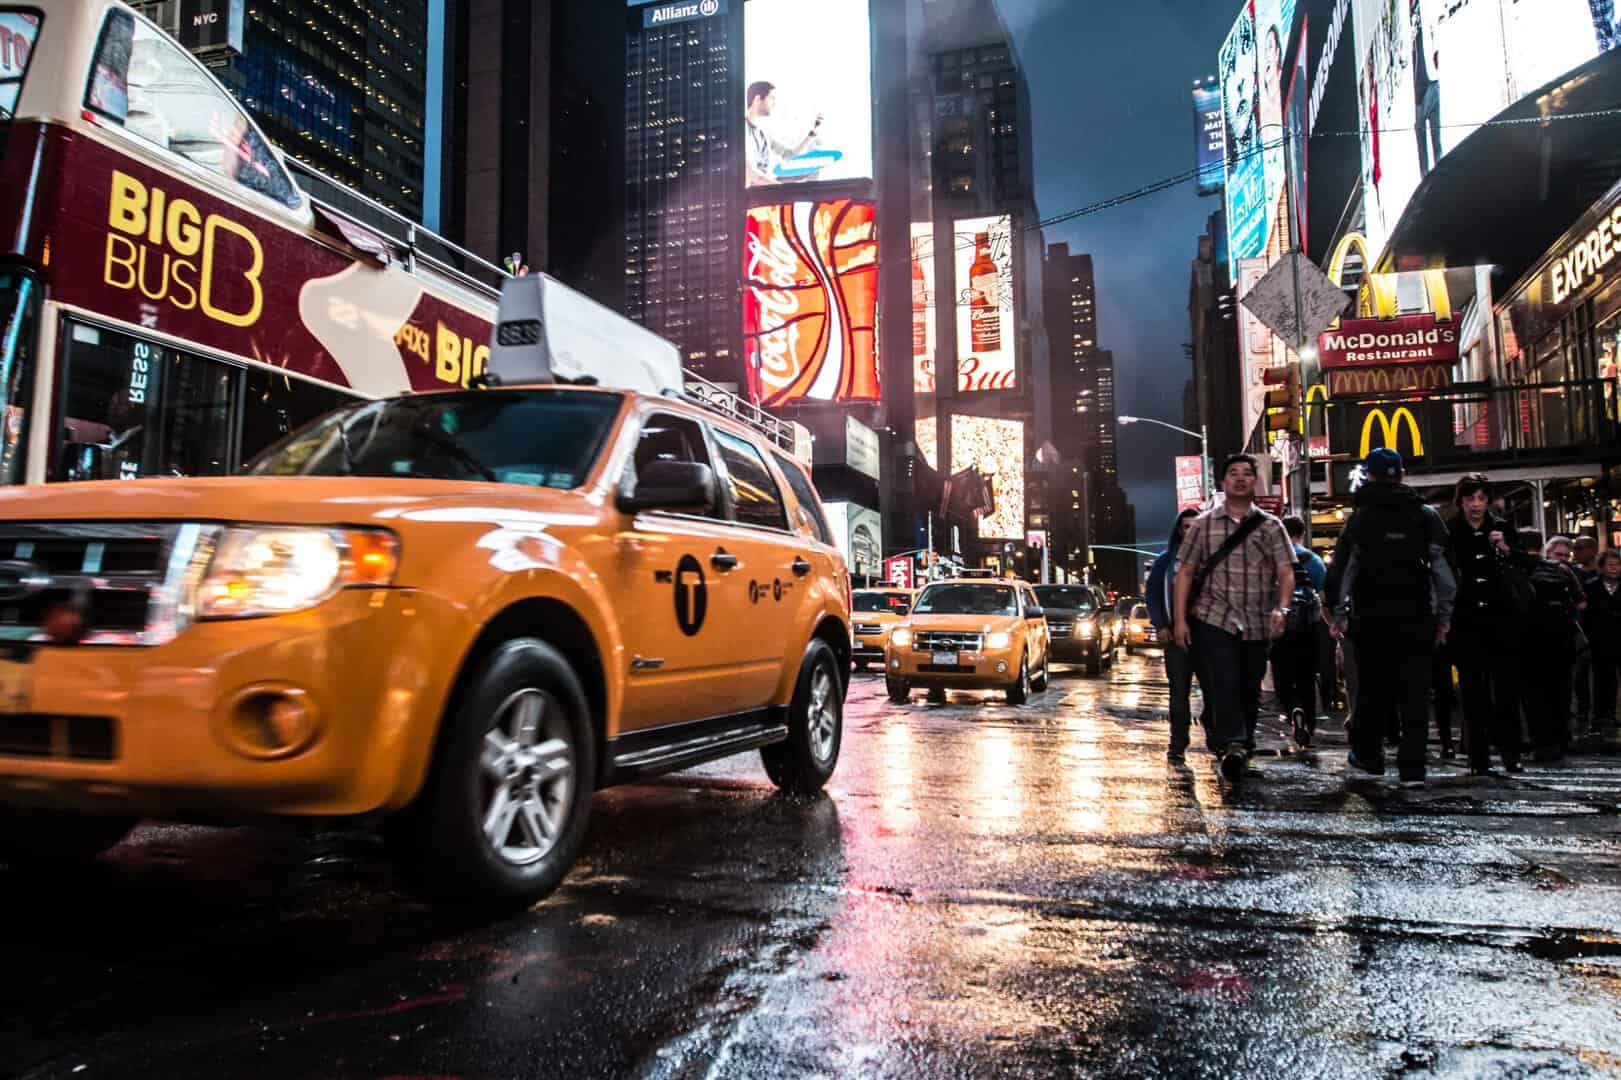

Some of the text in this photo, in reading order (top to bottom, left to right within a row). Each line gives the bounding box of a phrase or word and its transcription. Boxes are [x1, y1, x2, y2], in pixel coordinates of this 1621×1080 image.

[193, 13, 218, 26] NYC
[652, 4, 699, 23] Allianz
[109, 169, 201, 256] BIG
[104, 232, 198, 310] BUS
[1324, 328, 1455, 351] McDonald's
[1346, 347, 1433, 362] Restaurant
